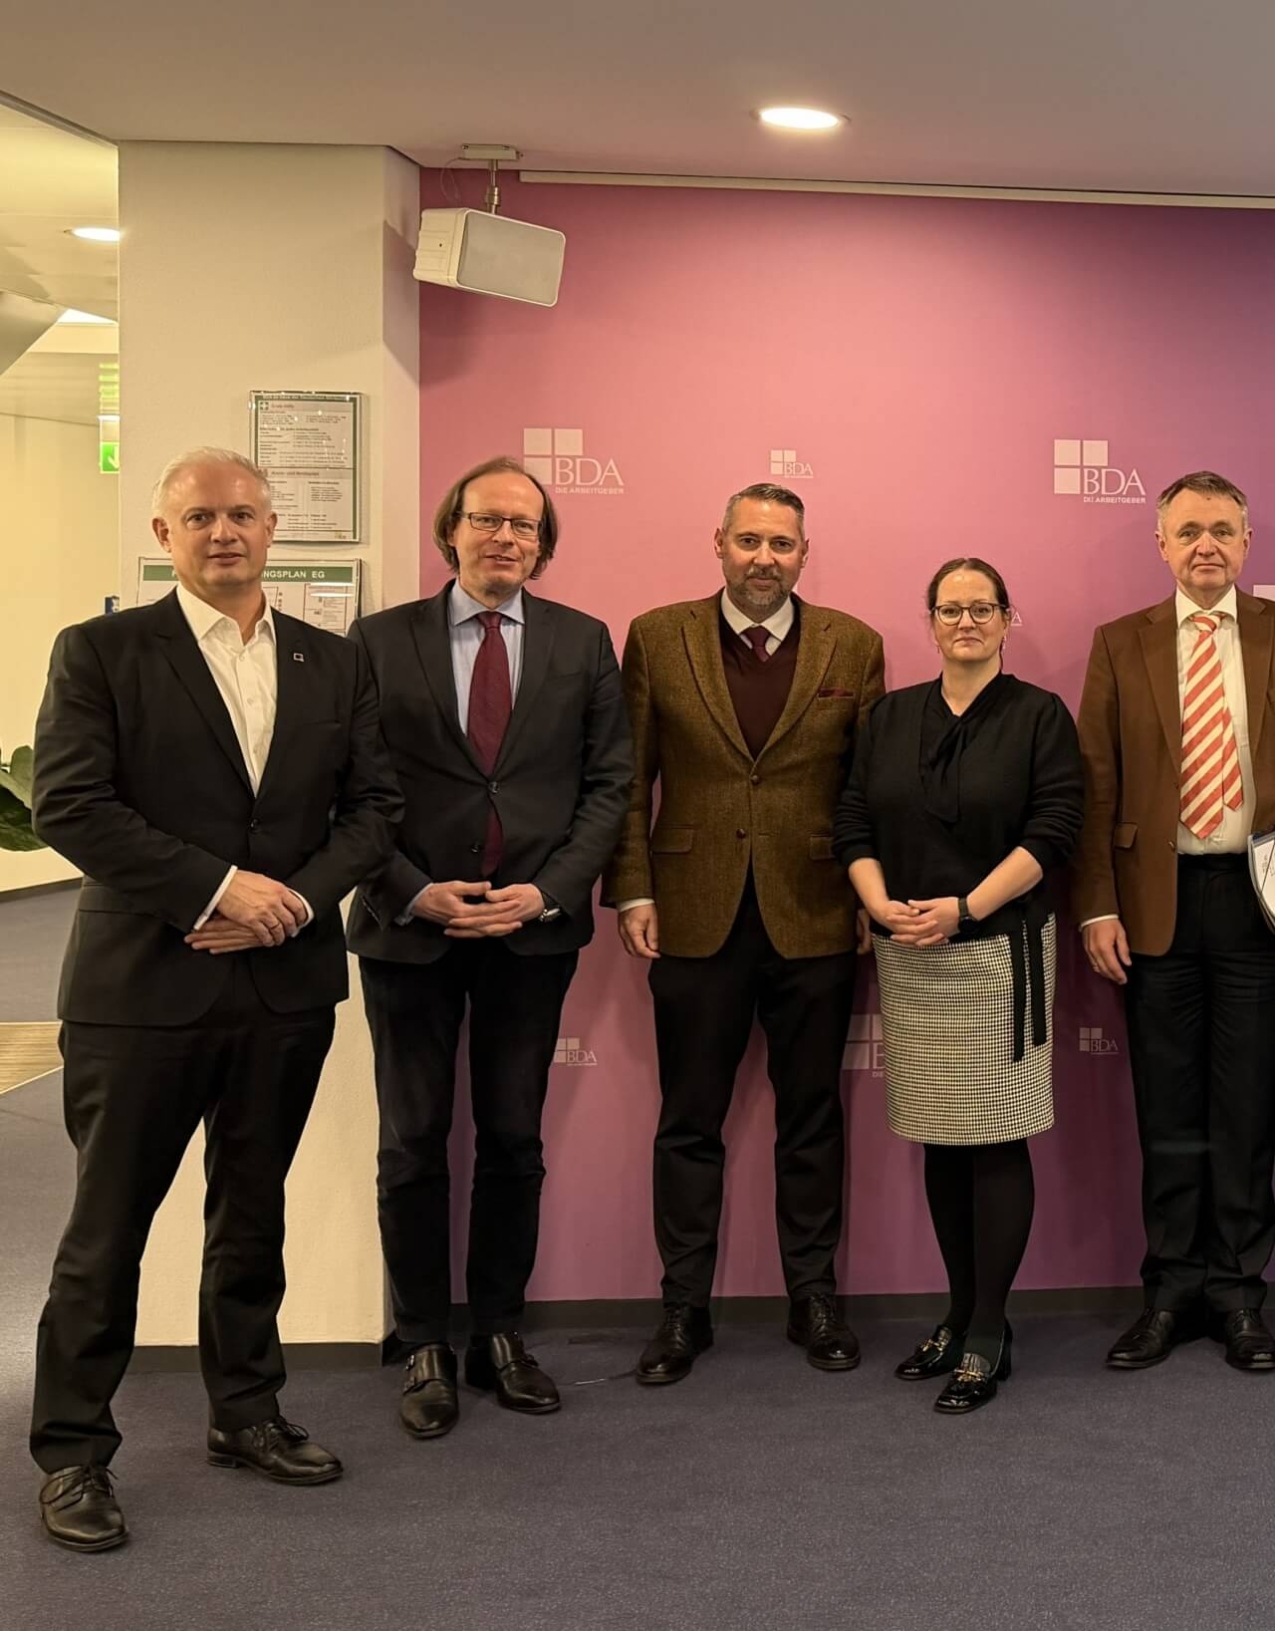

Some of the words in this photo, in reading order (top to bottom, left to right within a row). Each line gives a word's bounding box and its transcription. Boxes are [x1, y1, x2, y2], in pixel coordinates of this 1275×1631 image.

[555, 457, 624, 486] BDA
[784, 462, 814, 475] BDA
[1083, 468, 1146, 495] BDA
[1095, 496, 1146, 504] ARBEITGEBER
[263, 570, 307, 579] NGSPLAN
[311, 570, 325, 579] EG
[1091, 1039, 1119, 1052] BDA
[567, 1050, 597, 1063] BDA
